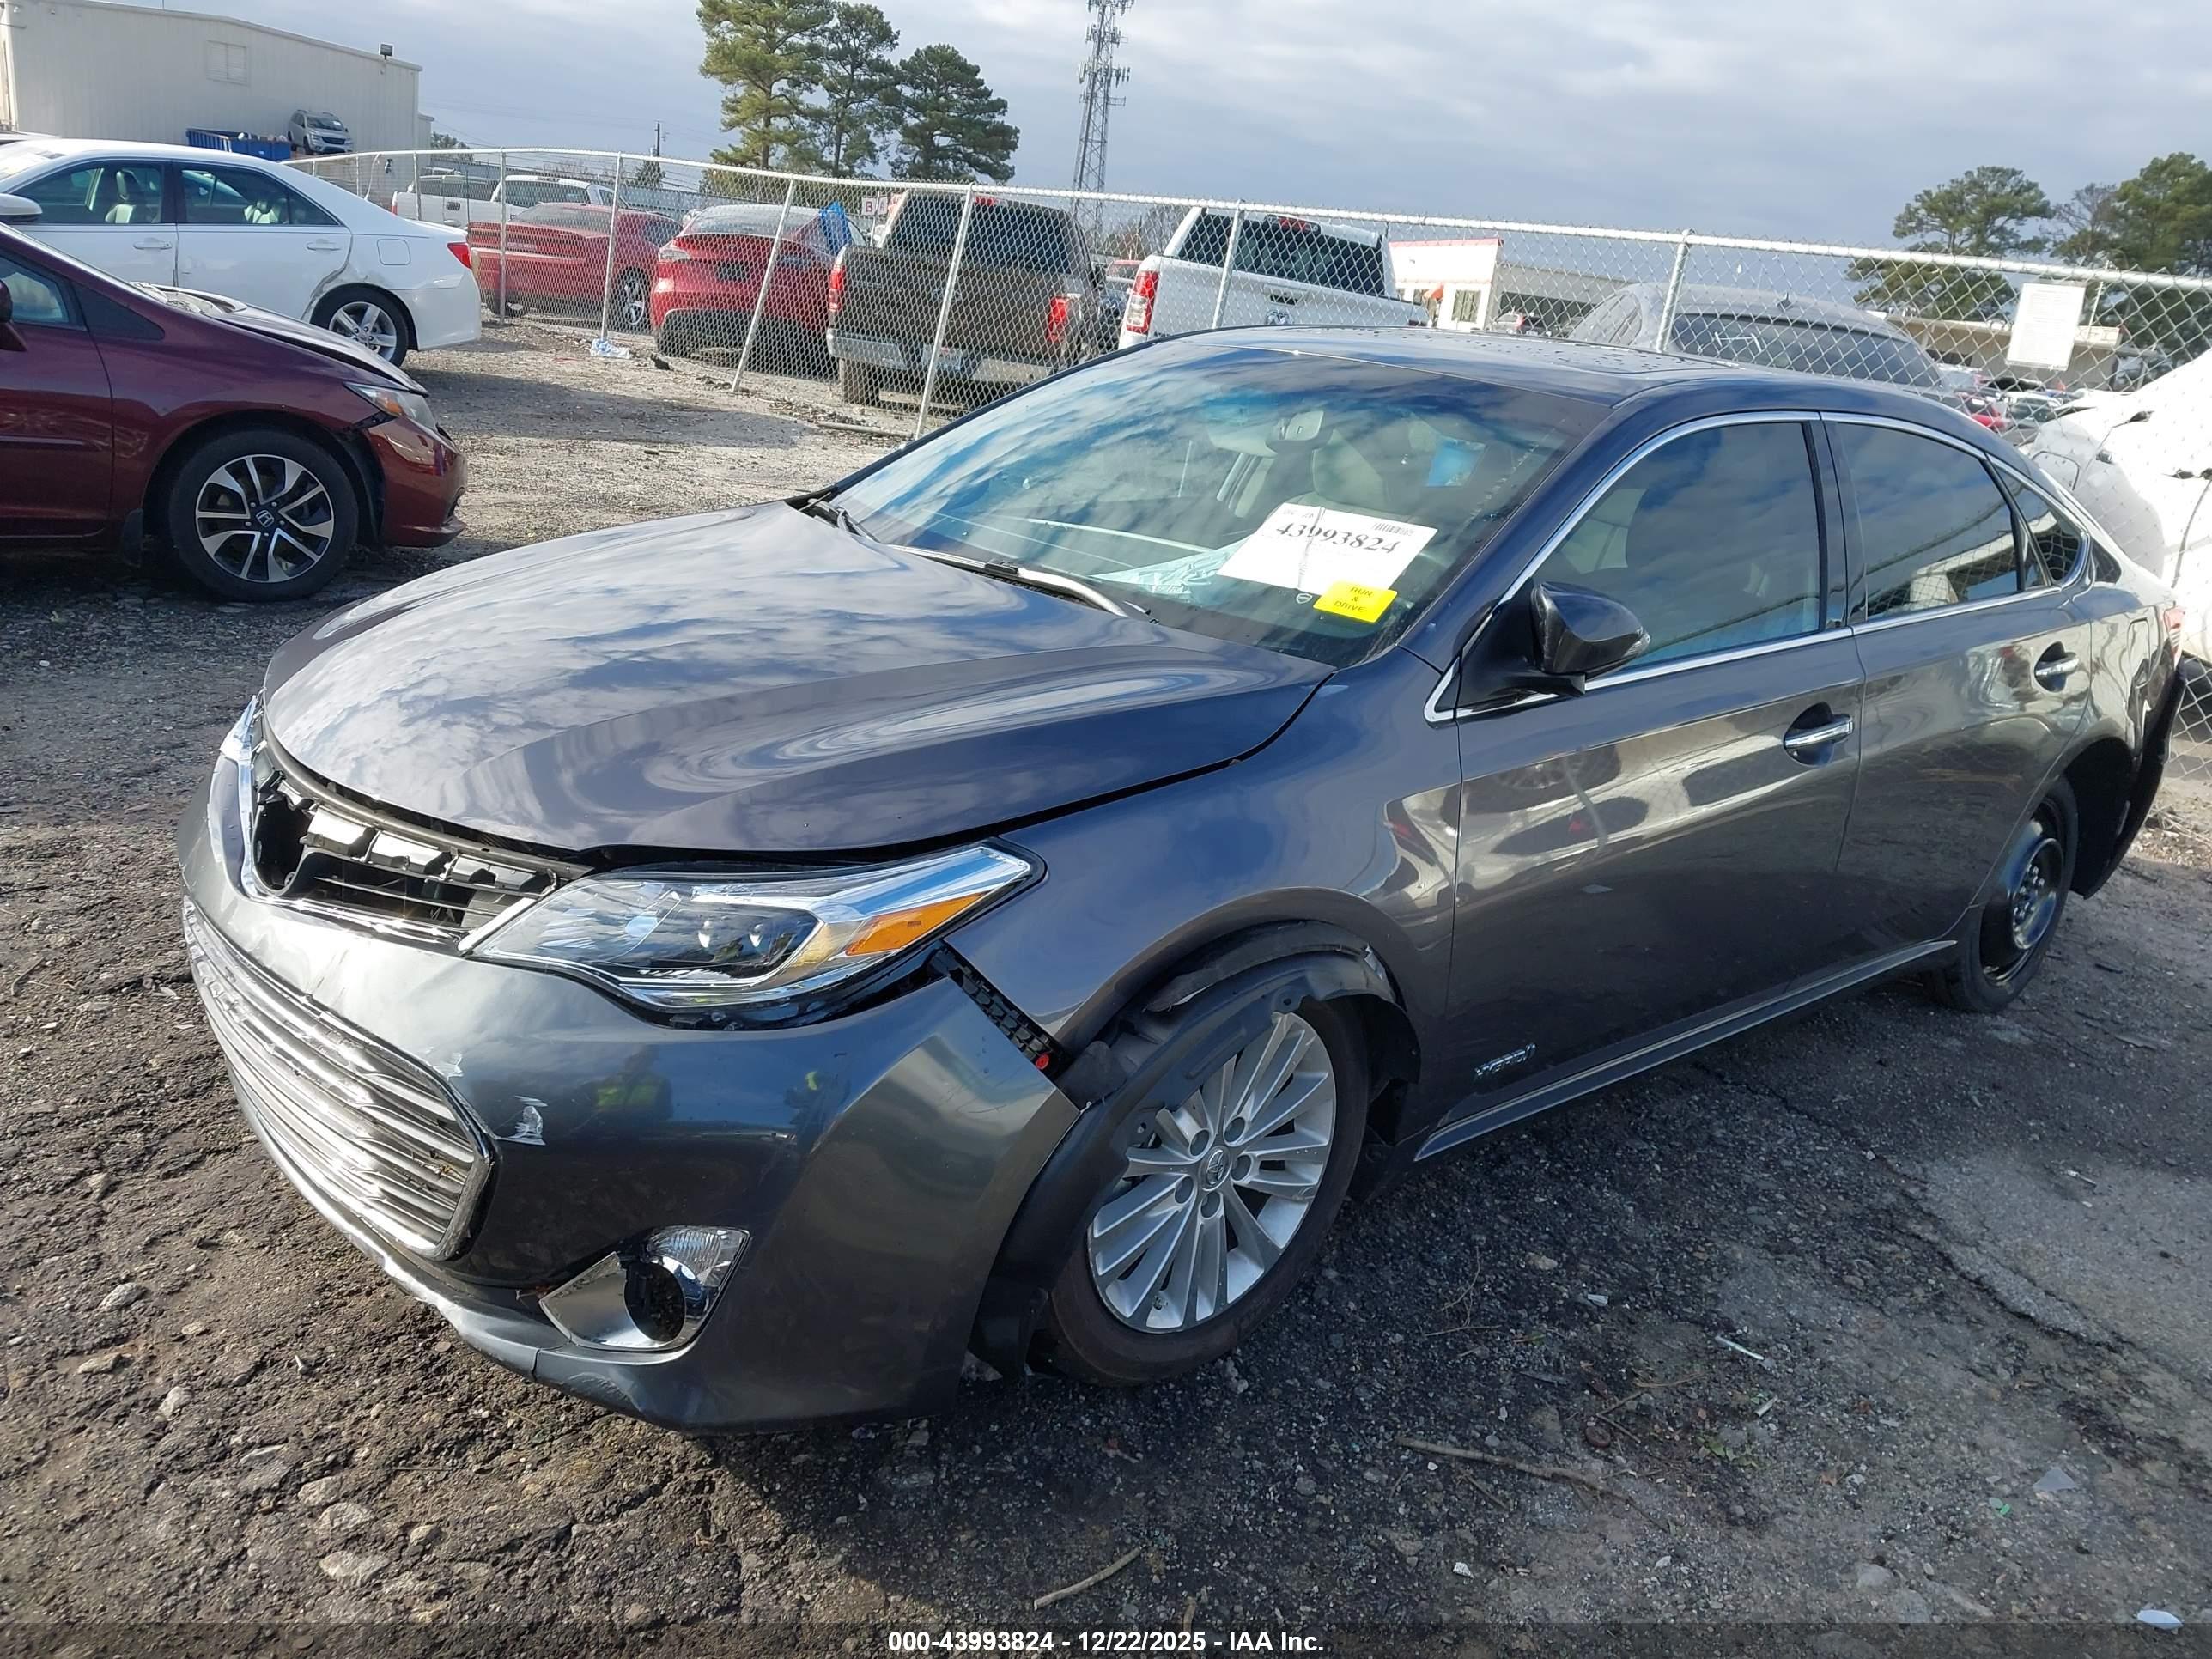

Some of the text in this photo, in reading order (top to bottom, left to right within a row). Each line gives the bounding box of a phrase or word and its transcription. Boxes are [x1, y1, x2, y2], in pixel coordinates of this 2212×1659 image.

[866, 201, 873, 213] B
[1350, 586, 1374, 597] RUN
[1334, 600, 1368, 612] DRIVE
